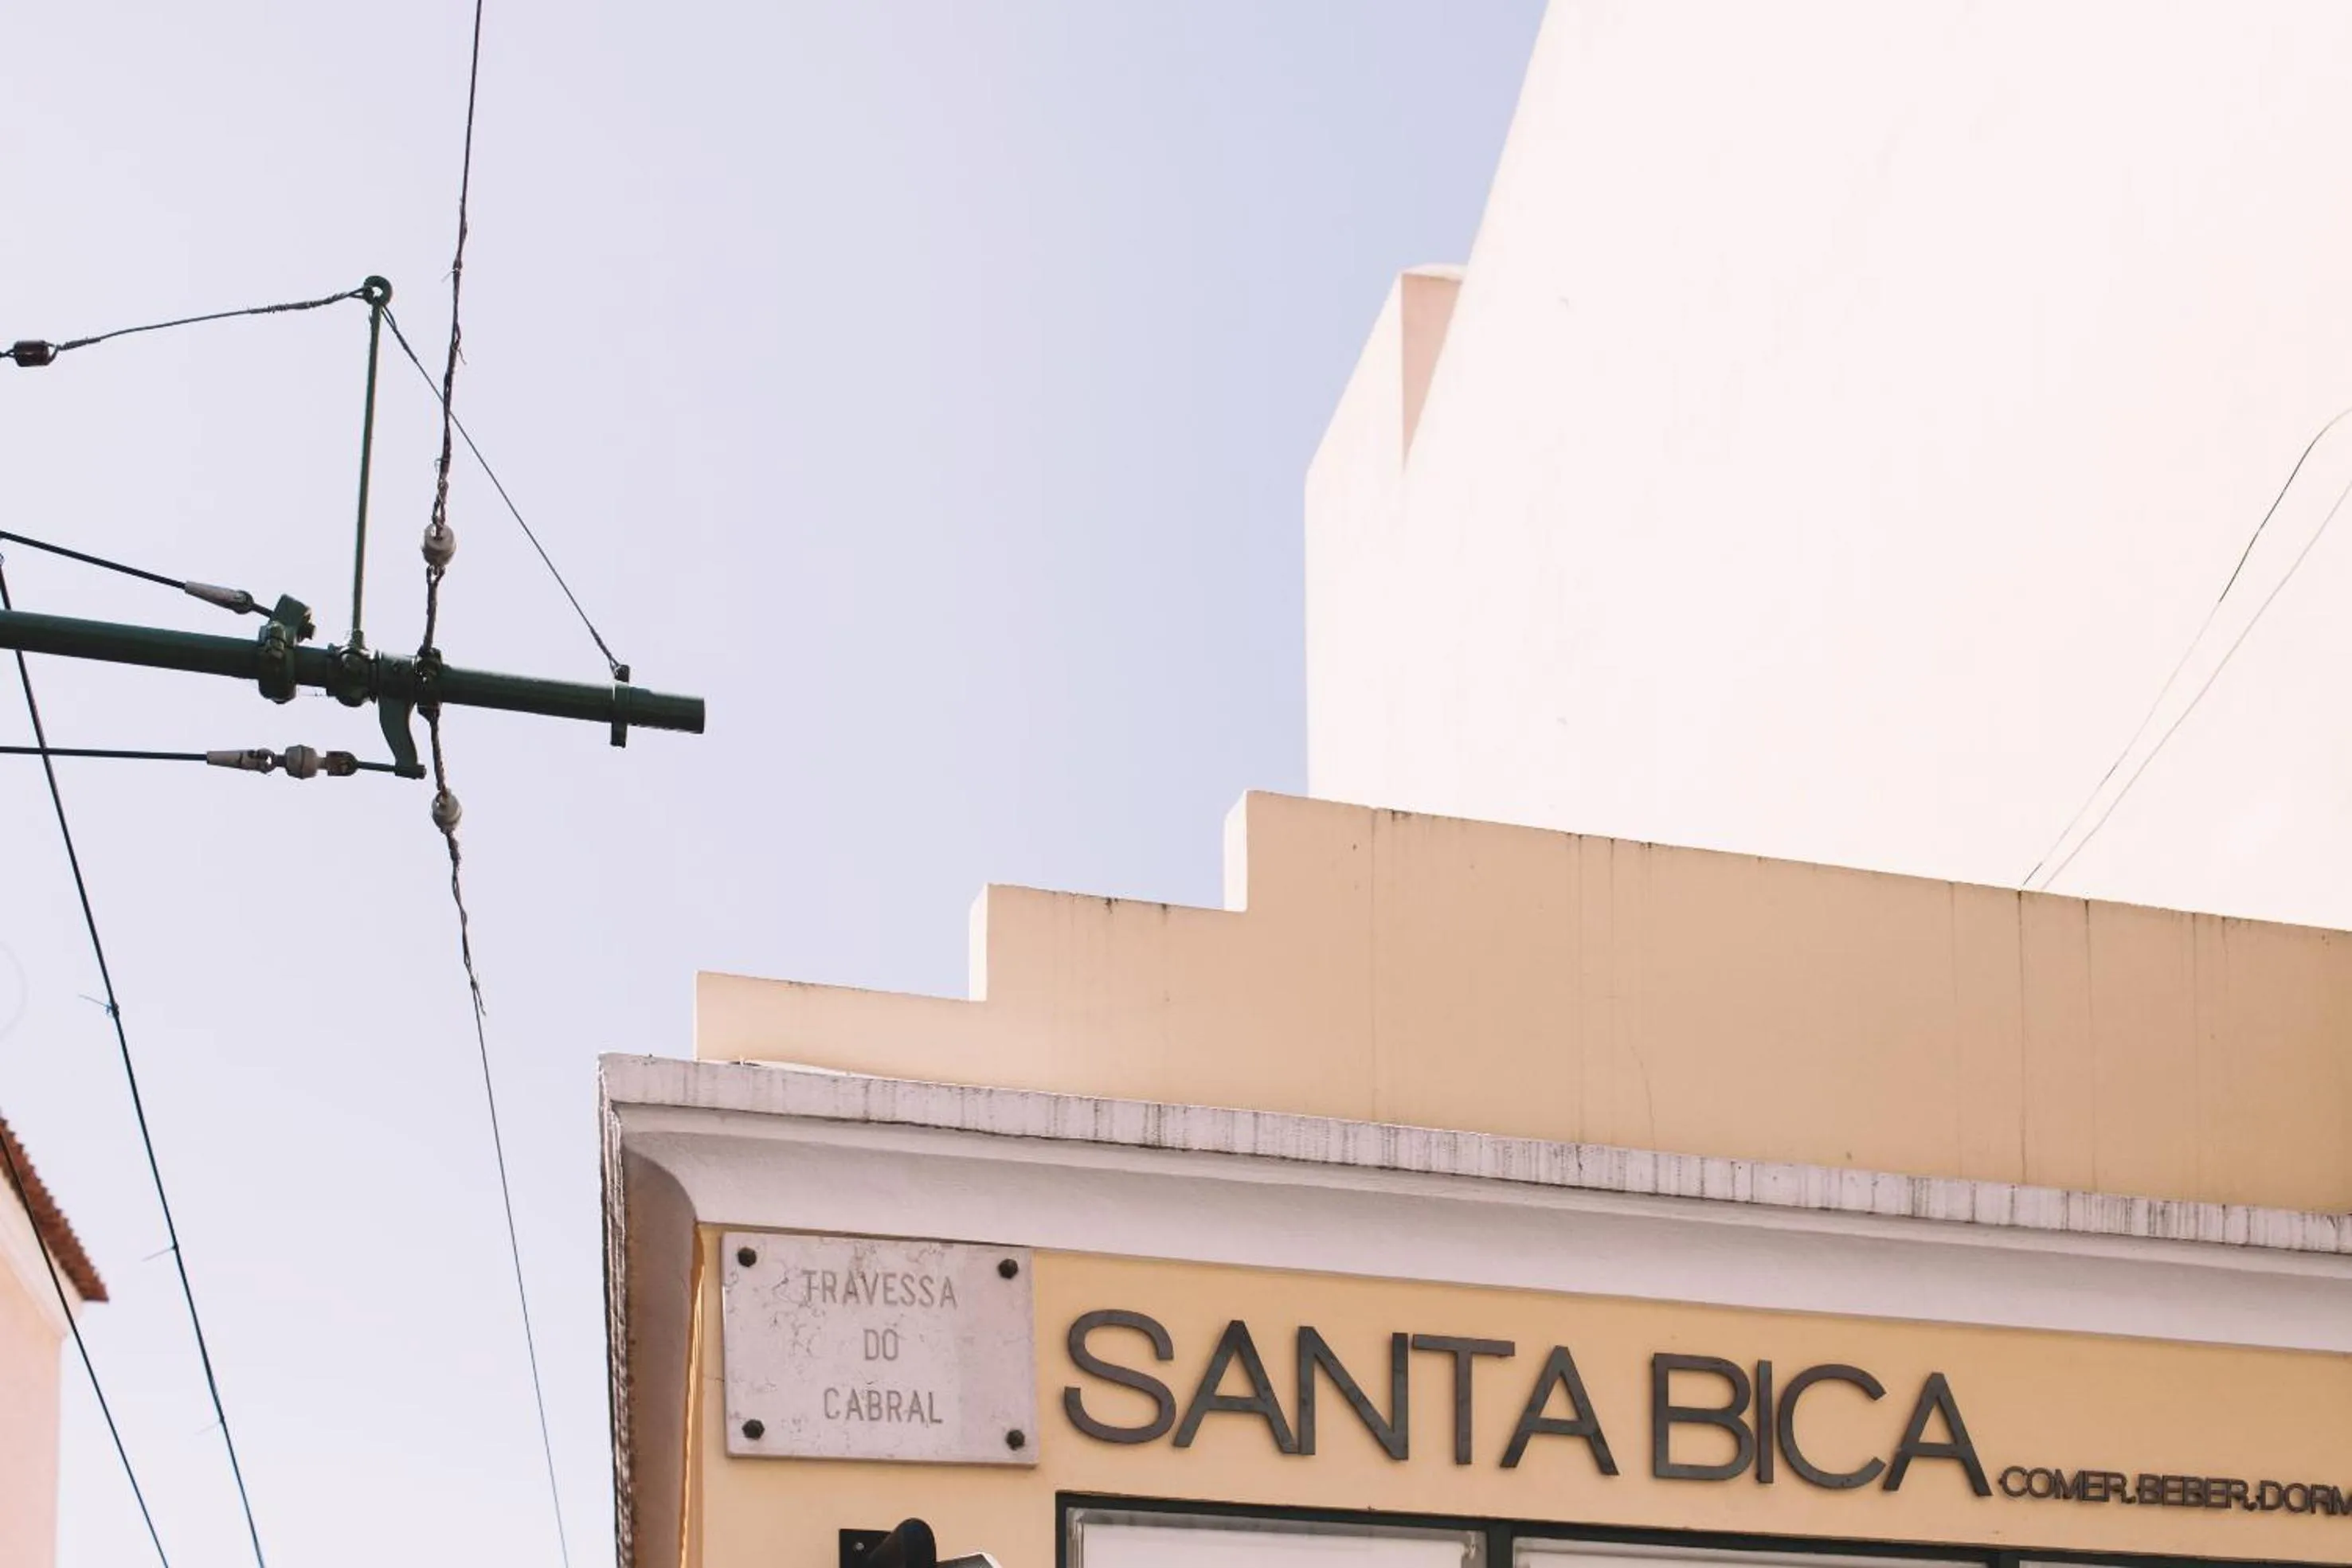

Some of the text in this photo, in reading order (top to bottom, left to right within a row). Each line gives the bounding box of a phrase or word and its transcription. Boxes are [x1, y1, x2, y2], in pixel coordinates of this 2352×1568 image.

[803, 1269, 958, 1309] TRAVESSA
[863, 1328, 899, 1361] DO
[823, 1386, 944, 1425] CABRAL
[1064, 1308, 1993, 1497] SANTA BICA
